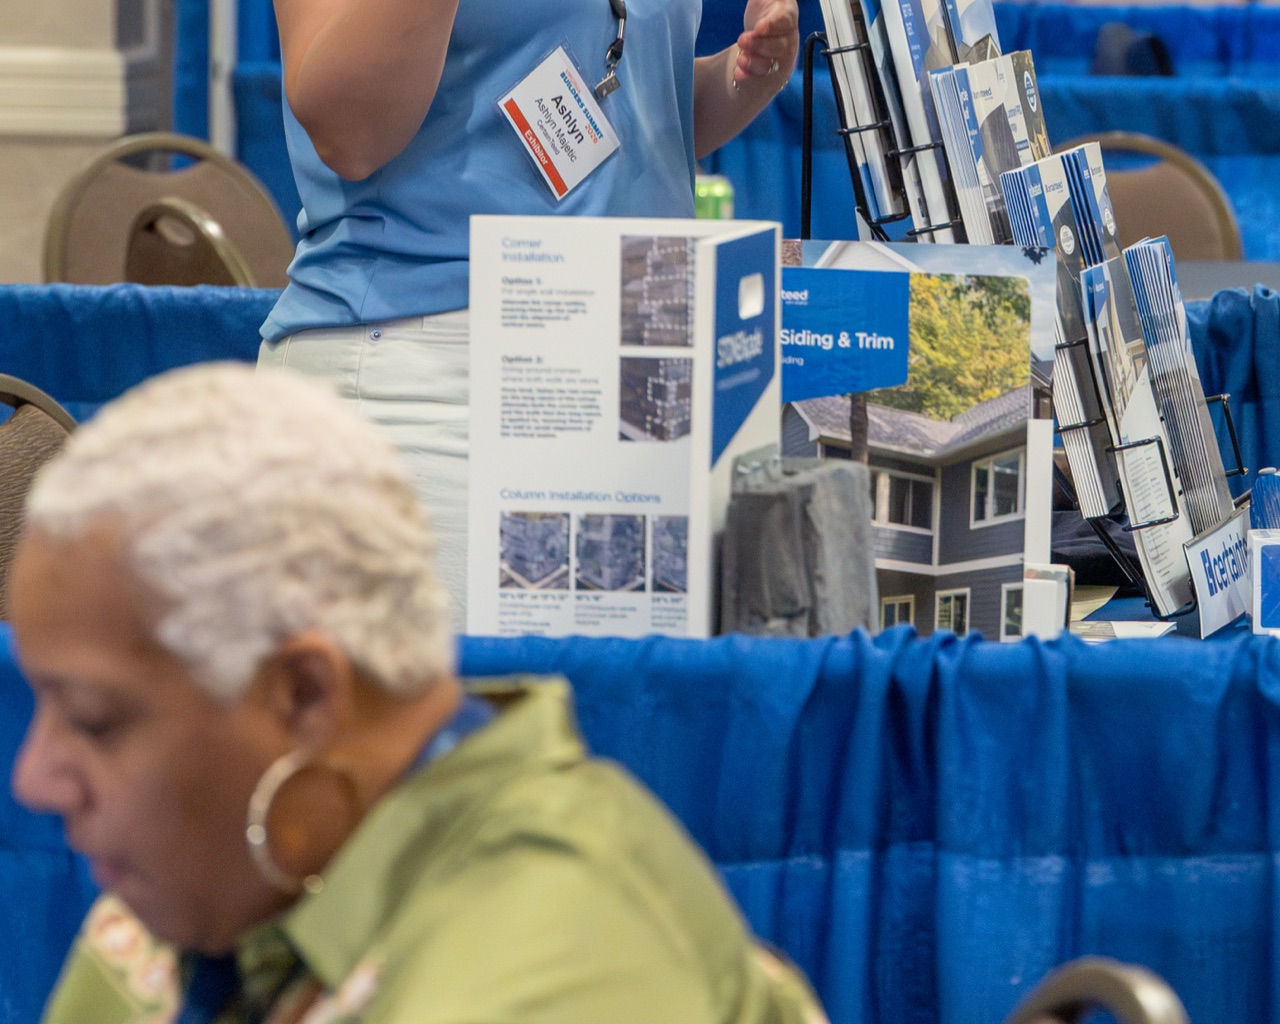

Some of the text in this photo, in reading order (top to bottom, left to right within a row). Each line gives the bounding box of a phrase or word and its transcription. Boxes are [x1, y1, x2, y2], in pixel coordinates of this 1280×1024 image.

[551, 94, 585, 144] Ashlyn
[559, 71, 605, 140] BUILDERS SUMMIT
[523, 129, 549, 166] Exhibitor
[535, 97, 578, 164] Ashlyn Majetic
[584, 124, 599, 145] 2026
[780, 328, 834, 351] Siding
[837, 331, 852, 348] &
[855, 332, 895, 351] Trim
